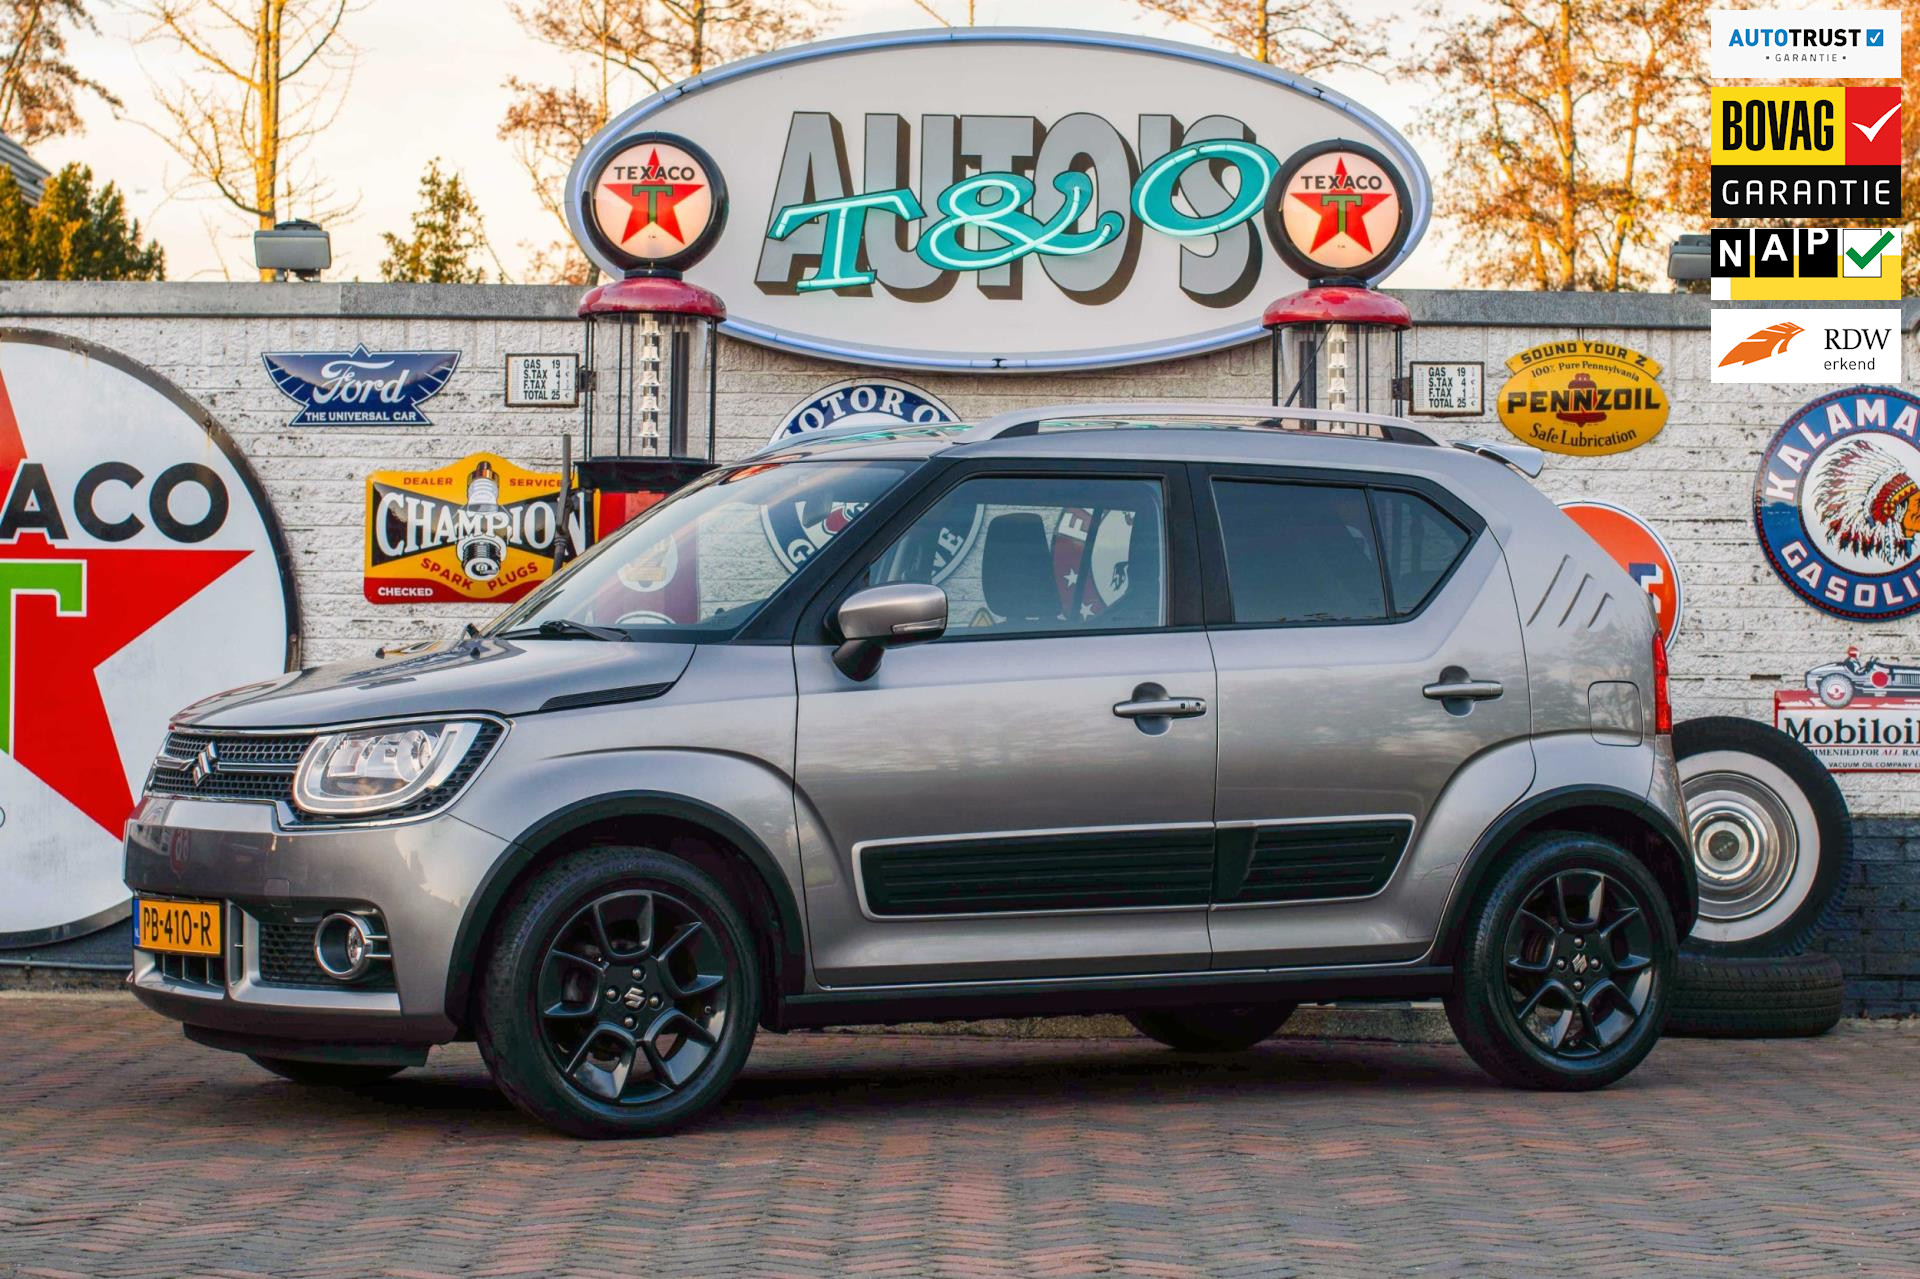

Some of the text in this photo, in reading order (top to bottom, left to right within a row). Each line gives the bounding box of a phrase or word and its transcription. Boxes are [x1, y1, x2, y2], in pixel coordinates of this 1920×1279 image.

[614, 166, 695, 181] TEXACO
[1300, 175, 1383, 190] TEXACO
[1520, 342, 1648, 367] SOUND YOUR Z
[523, 359, 561, 369] GAS 19
[523, 369, 561, 379] S.TAX 4
[1428, 367, 1466, 377] GAS 19
[1558, 361, 1581, 371] Pure
[1582, 361, 1640, 382] Pennsylvania
[312, 360, 411, 404] Ford
[523, 380, 560, 389] F.TAX 1
[1428, 377, 1466, 387] S.TAX 4
[523, 390, 561, 400] TOTAL 25
[1428, 388, 1466, 398] F.TAX 1
[1428, 398, 1467, 408] TOTAL 25
[1507, 387, 1661, 414] PENNZOIL
[305, 411, 417, 422] THE UNIVERSAL CAR
[784, 386, 905, 437] OTOR
[1529, 422, 1638, 448] Safe Lubrication
[1765, 398, 1920, 502] KALAMA
[403, 477, 453, 486] DEALER
[420, 557, 539, 591] SPARK PLUGS
[377, 586, 433, 597] CHECKED
[1860, 748, 1879, 756] FOR
[144, 906, 212, 947] PB-410-R
